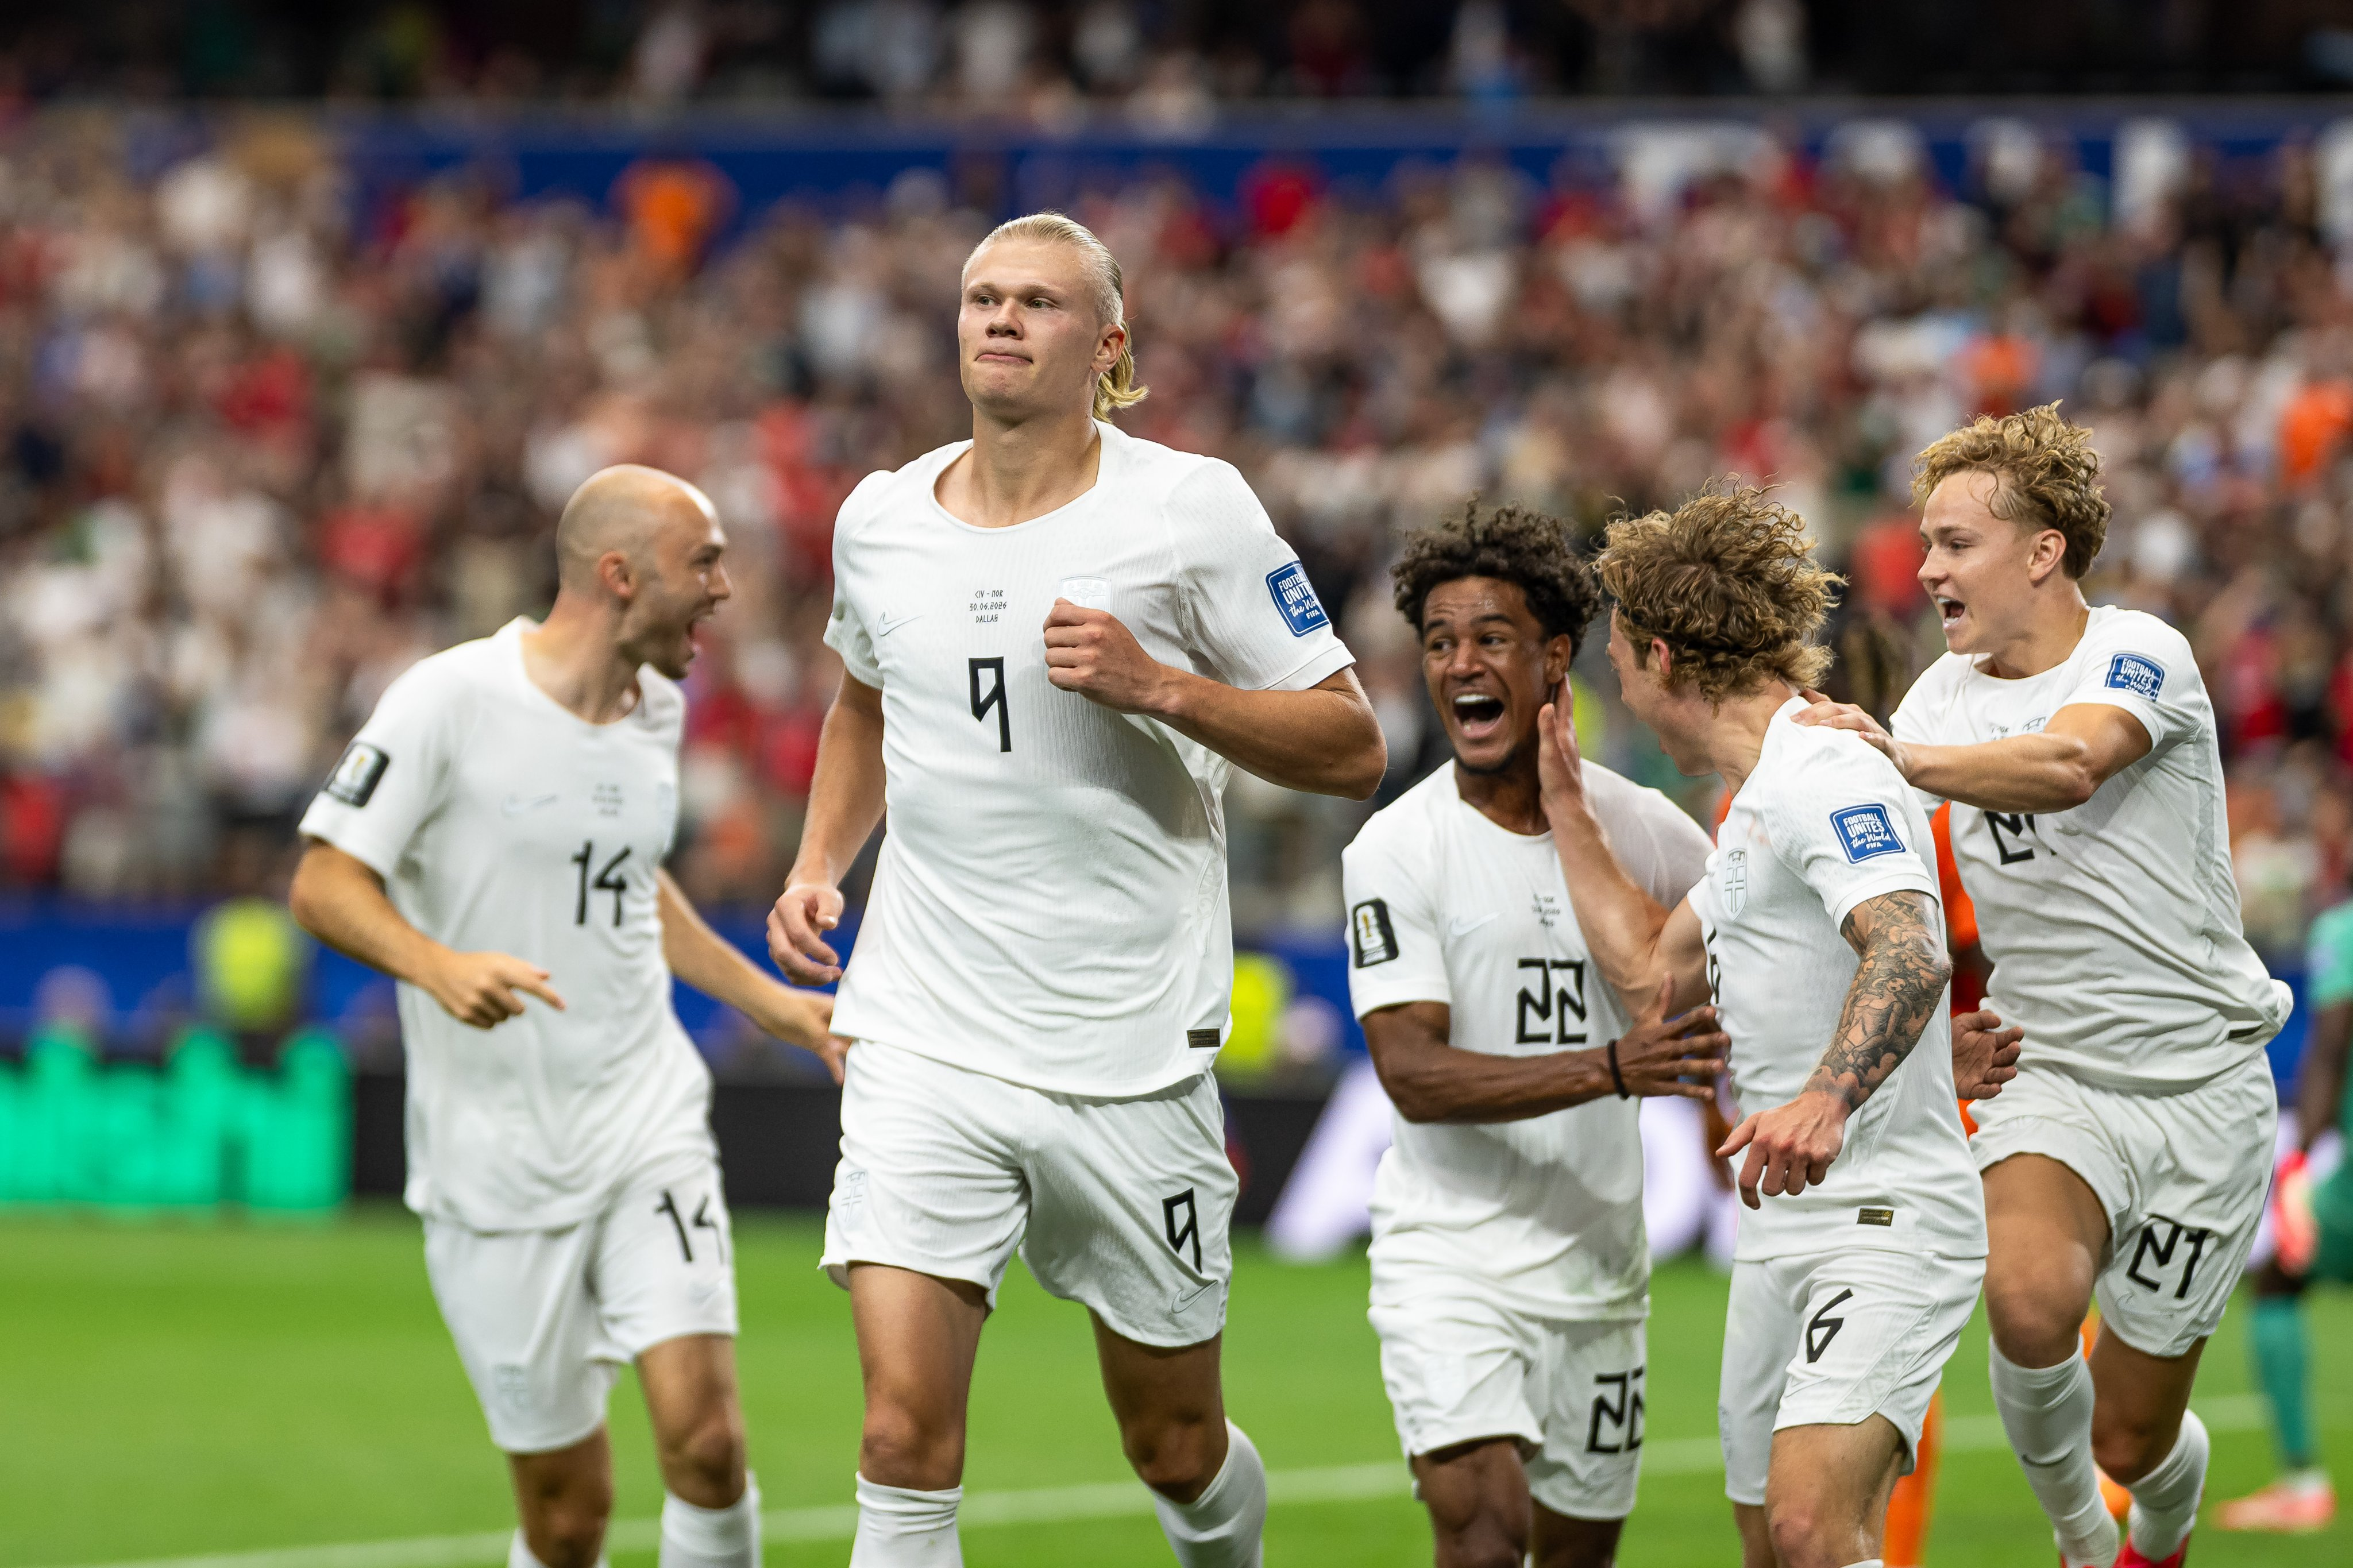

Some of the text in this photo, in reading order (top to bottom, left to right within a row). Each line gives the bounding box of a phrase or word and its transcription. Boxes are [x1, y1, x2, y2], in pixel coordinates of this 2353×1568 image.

[975, 590, 985, 598] CIV
[992, 589, 1004, 598] NOR
[969, 601, 1007, 611] 30.06.2026
[1289, 604, 1305, 617] the
[1306, 609, 1320, 619] FIFA
[976, 614, 998, 623] DALLAS
[968, 656, 1012, 753] 9
[1842, 813, 1880, 827] FOOTBALL
[1846, 821, 1885, 838] UNITES
[1984, 810, 2057, 865] 2
[1850, 832, 1891, 848] the World
[1865, 841, 1883, 849] FIFA
[572, 840, 632, 927] 14
[1515, 957, 1587, 1045] 22
[654, 1189, 727, 1266] 14
[1162, 1187, 1202, 1275] 9
[2126, 1213, 2211, 1299] 21
[1806, 1288, 1854, 1364] 6
